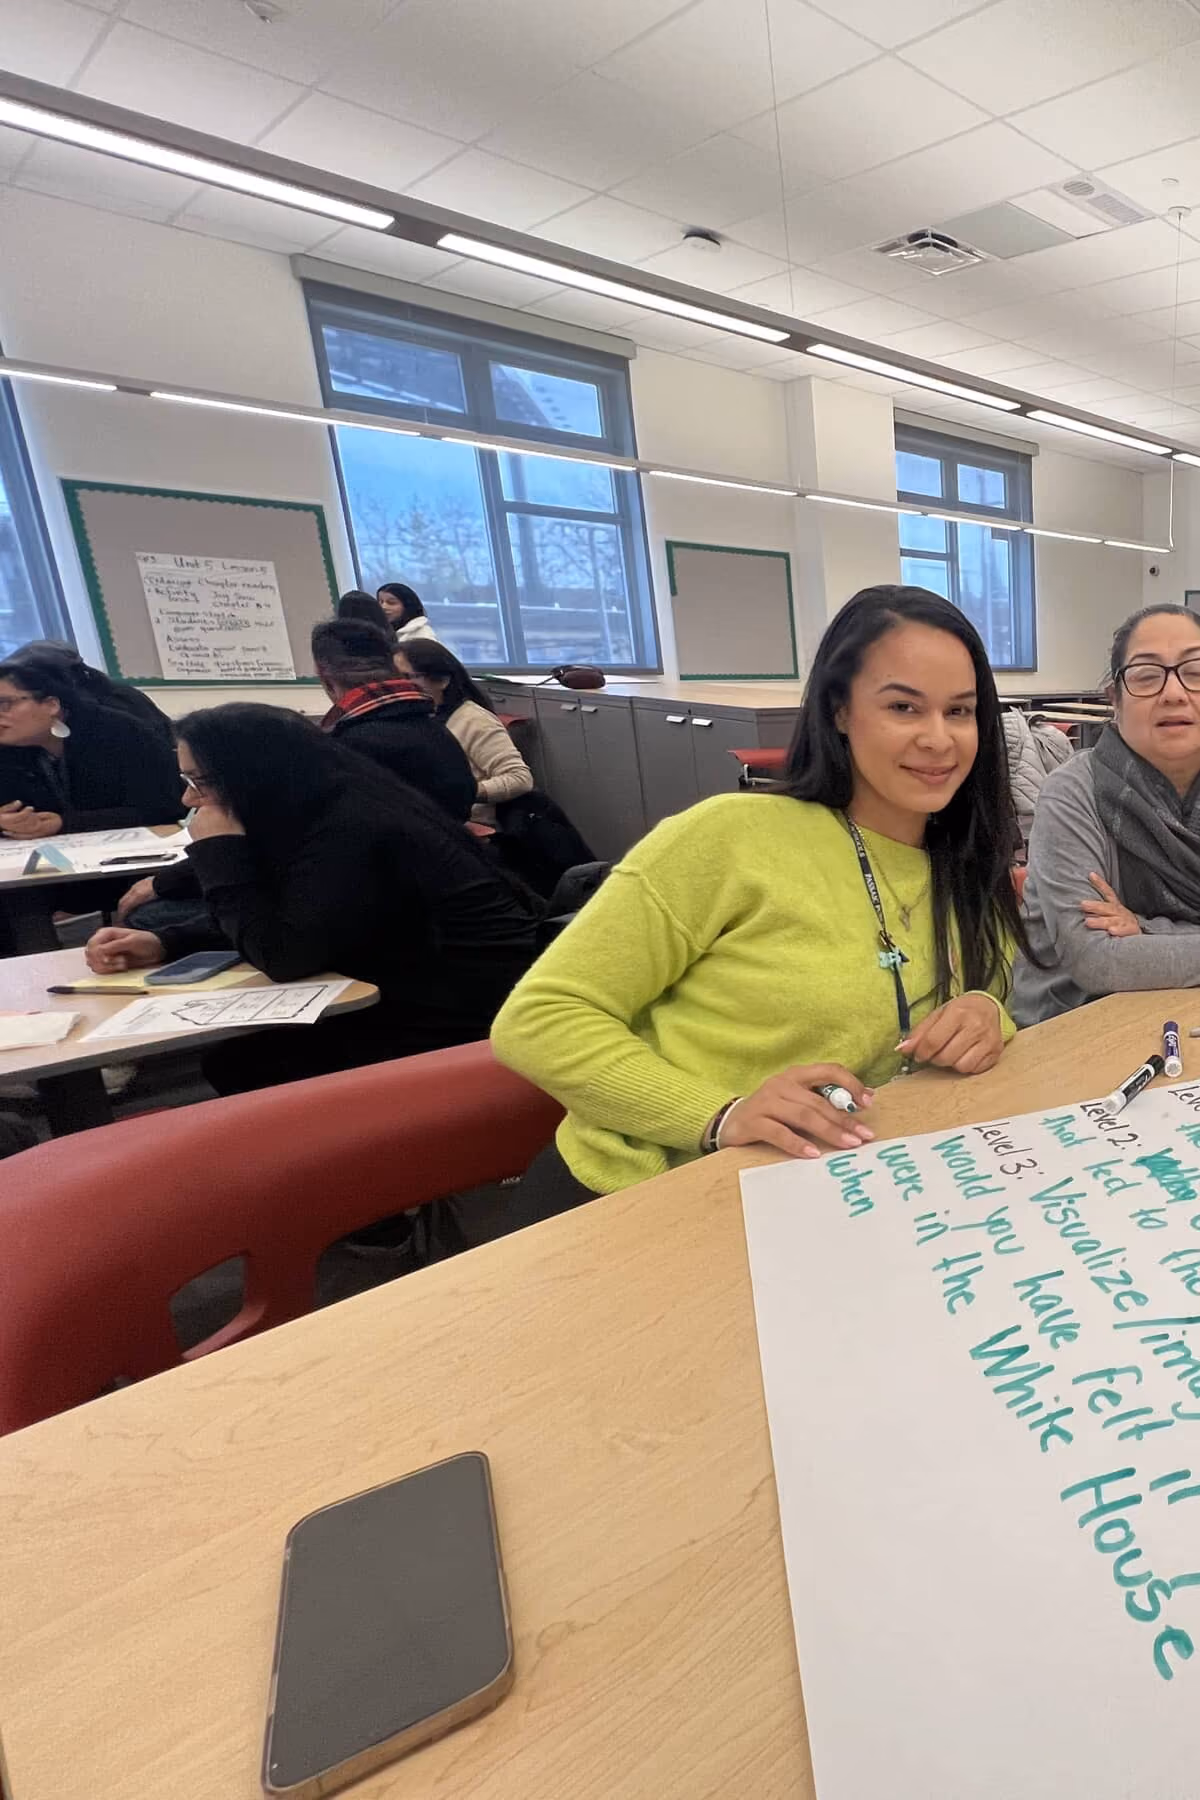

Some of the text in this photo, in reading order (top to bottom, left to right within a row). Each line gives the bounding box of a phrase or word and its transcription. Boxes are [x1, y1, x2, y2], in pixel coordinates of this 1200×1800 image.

[972, 1121, 1033, 1157] Level
[1079, 1102, 1130, 1134] Level
[1106, 1133, 1142, 1150] 2:
[1000, 1157, 1045, 1180] 3:
[1039, 1114, 1097, 1148] that
[1082, 1158, 1143, 1197] led
[1128, 1208, 1168, 1230] to
[950, 1206, 1025, 1254] you
[1013, 1269, 1081, 1349] have
[877, 1143, 1195, 1681] were in the White House
